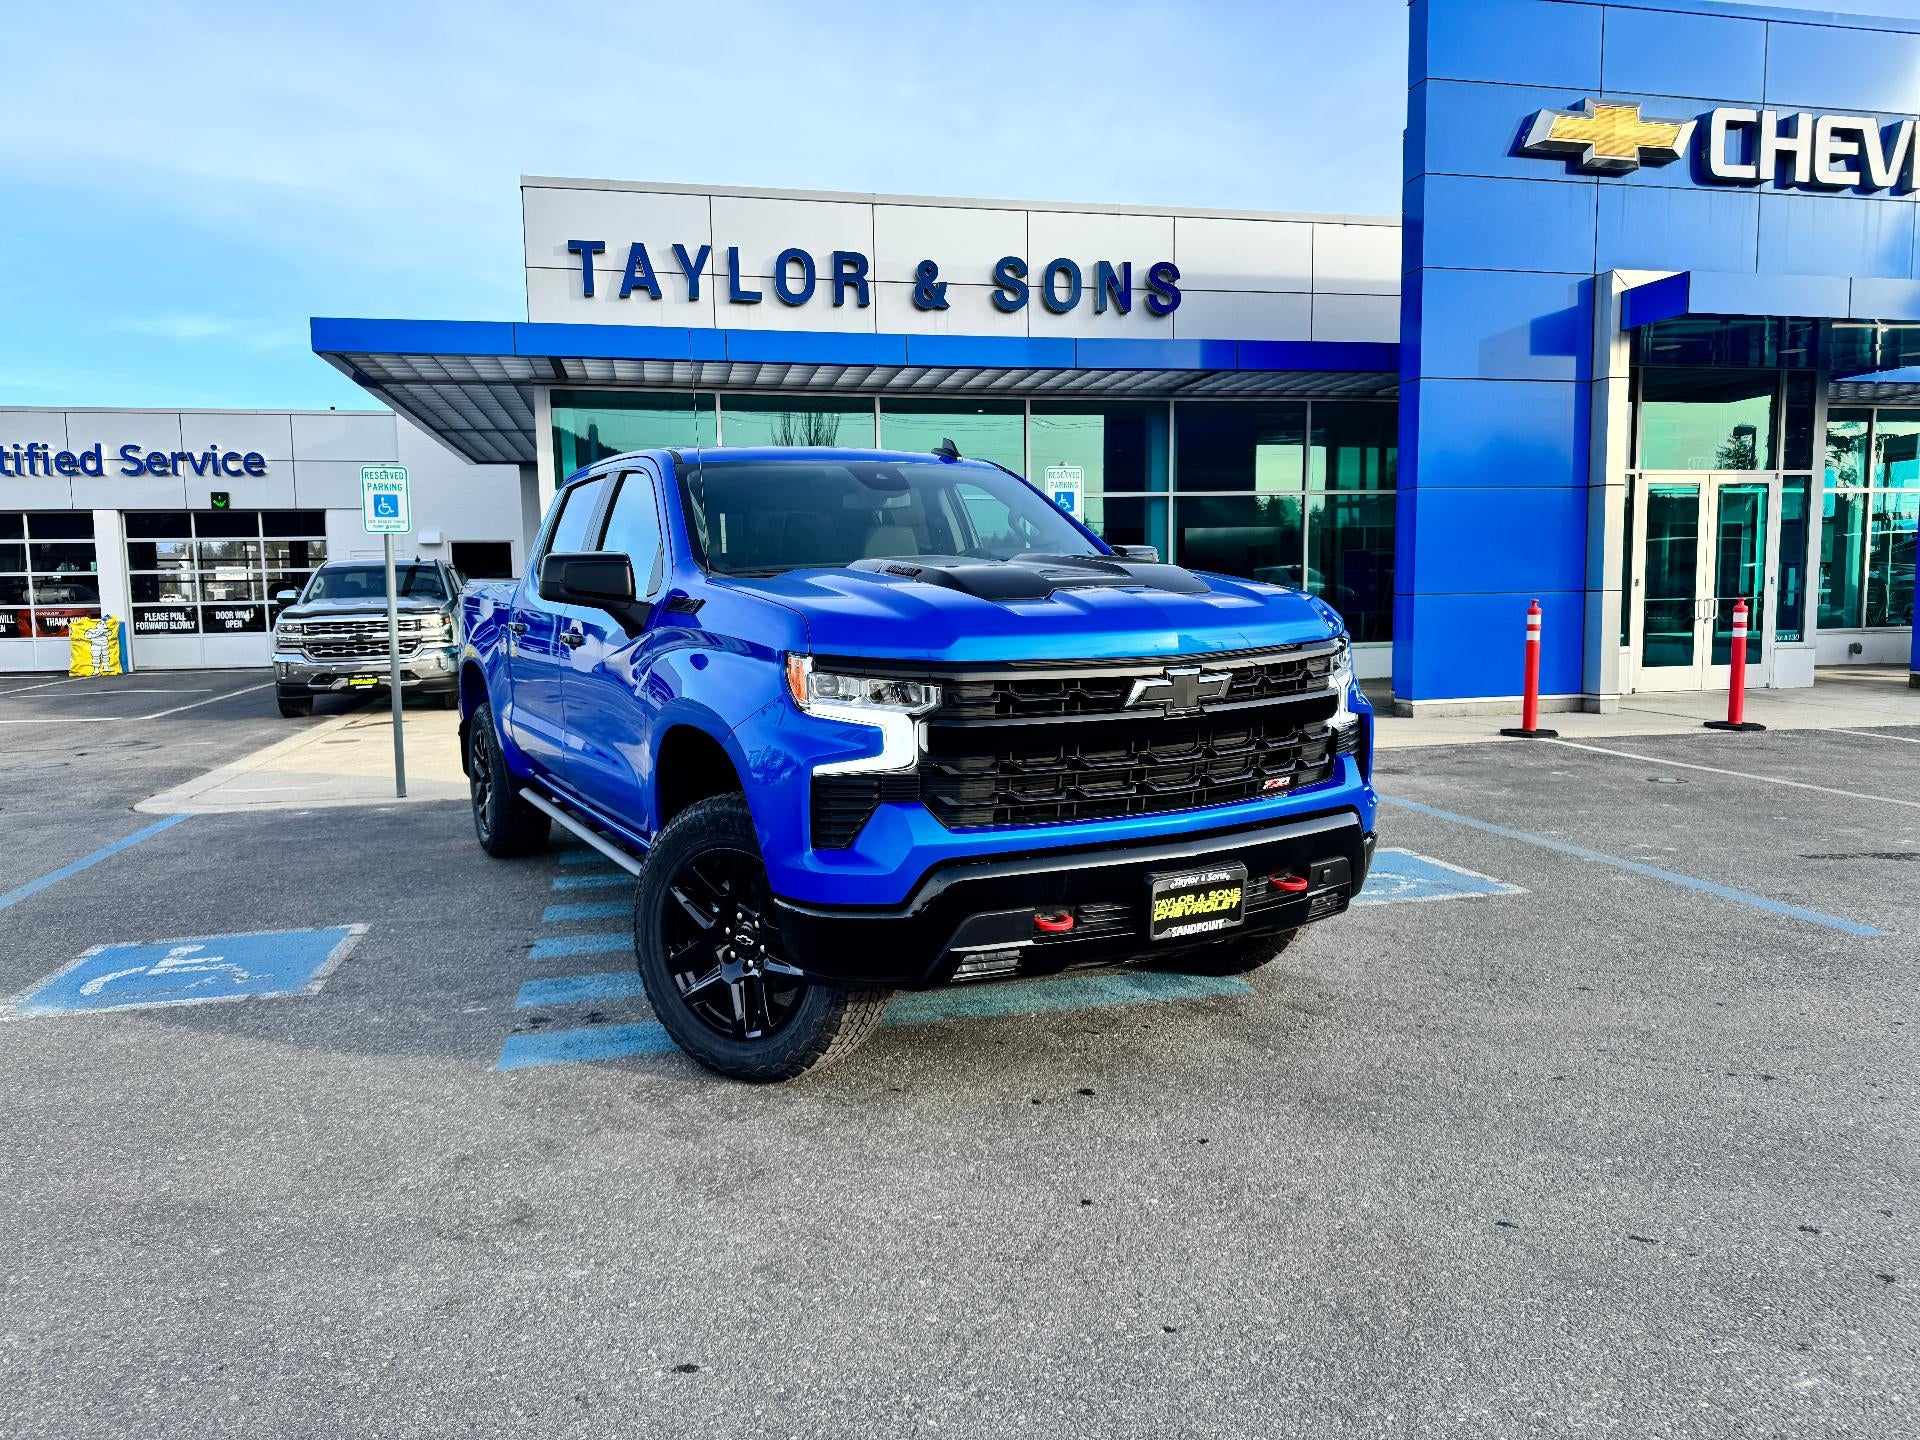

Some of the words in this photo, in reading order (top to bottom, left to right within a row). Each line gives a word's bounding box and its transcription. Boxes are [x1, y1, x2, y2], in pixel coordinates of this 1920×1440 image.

[1710, 107, 1920, 189] CHEV
[568, 239, 871, 307] TAYLOR
[914, 259, 951, 311] &
[992, 256, 1182, 315] SONS
[119, 444, 267, 477] Service
[364, 471, 404, 480] RESERVED
[1048, 471, 1080, 479] RESERVED
[367, 482, 403, 491] PARKING
[1050, 481, 1079, 489] PARKING
[144, 612, 168, 621] PLEASE
[170, 612, 186, 620] PULL
[216, 611, 234, 620] DOOR
[46, 617, 68, 627] THANK
[136, 620, 168, 630] FORWARD
[170, 620, 195, 630] SLOWLY
[225, 620, 242, 628] OPEN
[1154, 895, 1196, 910] TAYLOR
[1198, 894, 1205, 903] &
[1208, 888, 1242, 900] SONS
[1154, 898, 1242, 922] CHEVROLET
[1171, 918, 1225, 938] SANDPOINT
